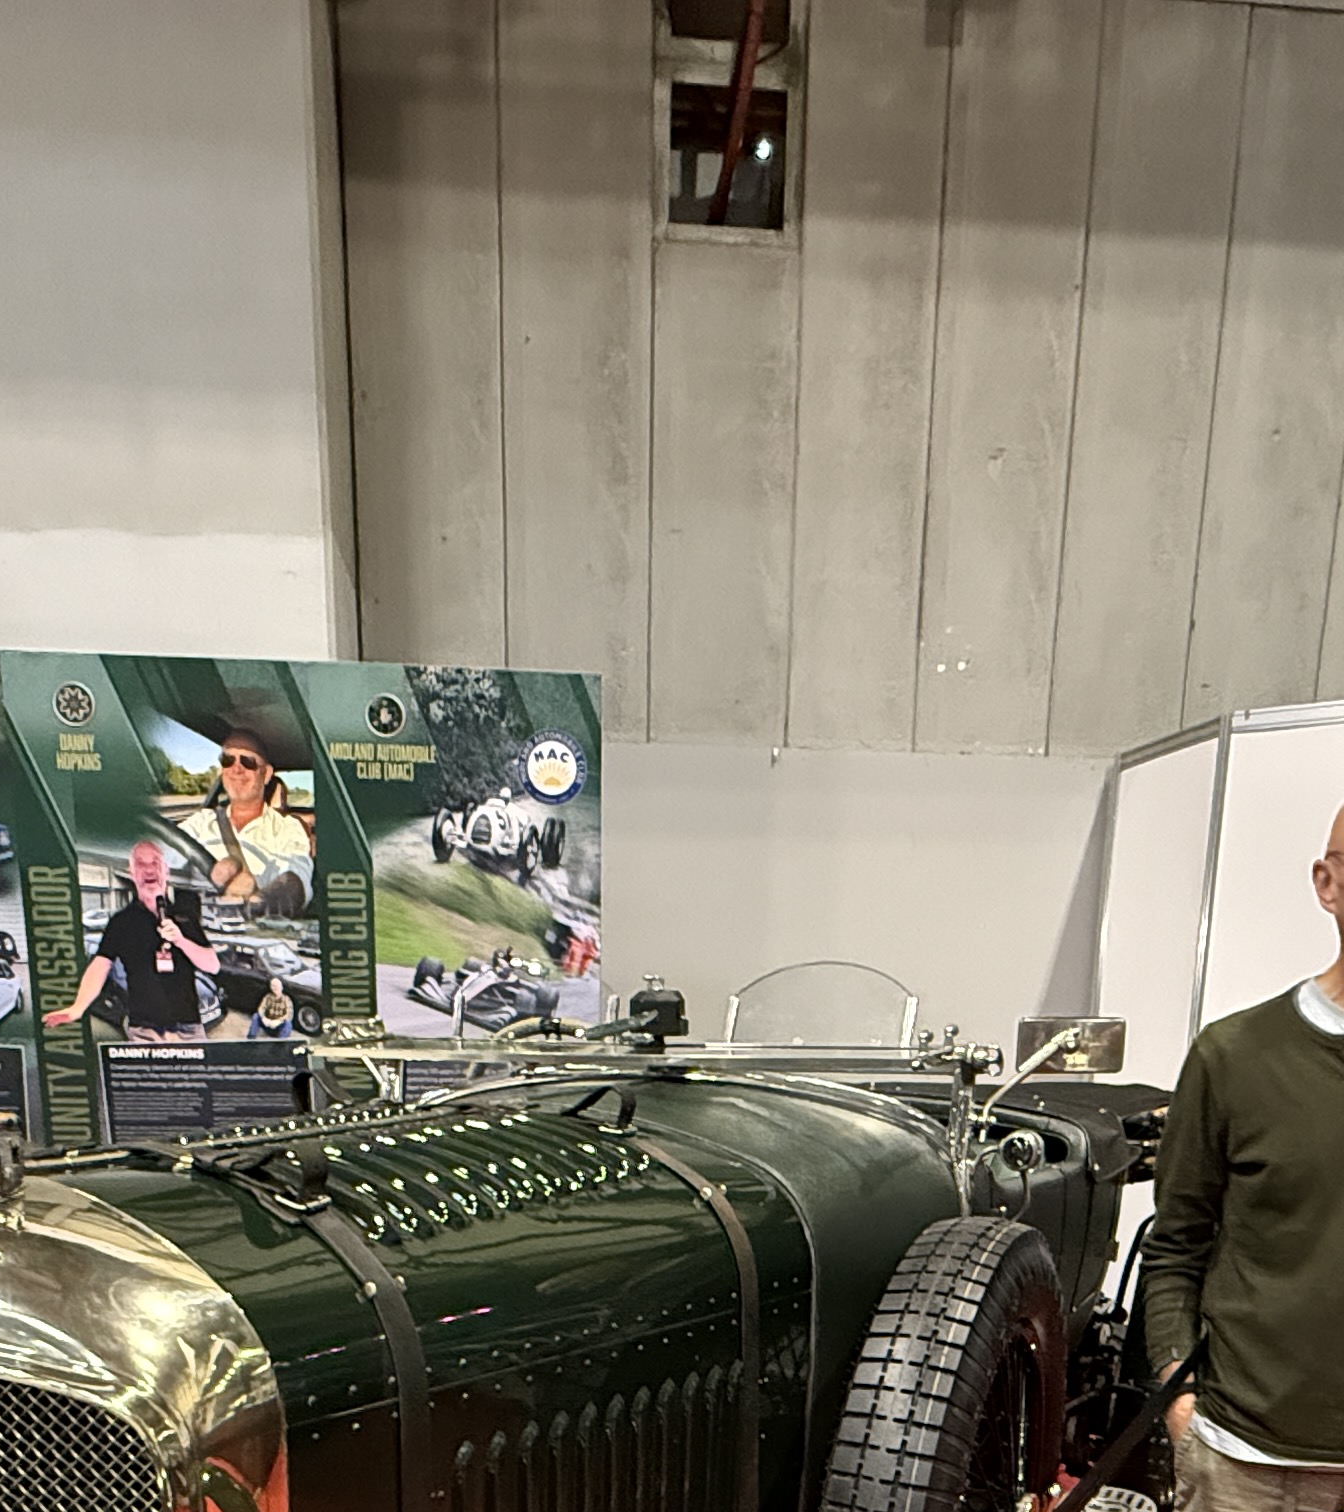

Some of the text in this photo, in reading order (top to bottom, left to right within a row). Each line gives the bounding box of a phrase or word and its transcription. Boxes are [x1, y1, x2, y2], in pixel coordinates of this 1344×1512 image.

[59, 733, 95, 751] DANNY
[56, 751, 102, 772] HOPKINS
[329, 742, 437, 764] MIDLAND AUTOMOBILE
[533, 747, 570, 763] MAC
[357, 762, 414, 782] CLUB (MAC)
[326, 871, 368, 941] CLUB
[108, 1047, 205, 1060] DANNY HOPKINS
